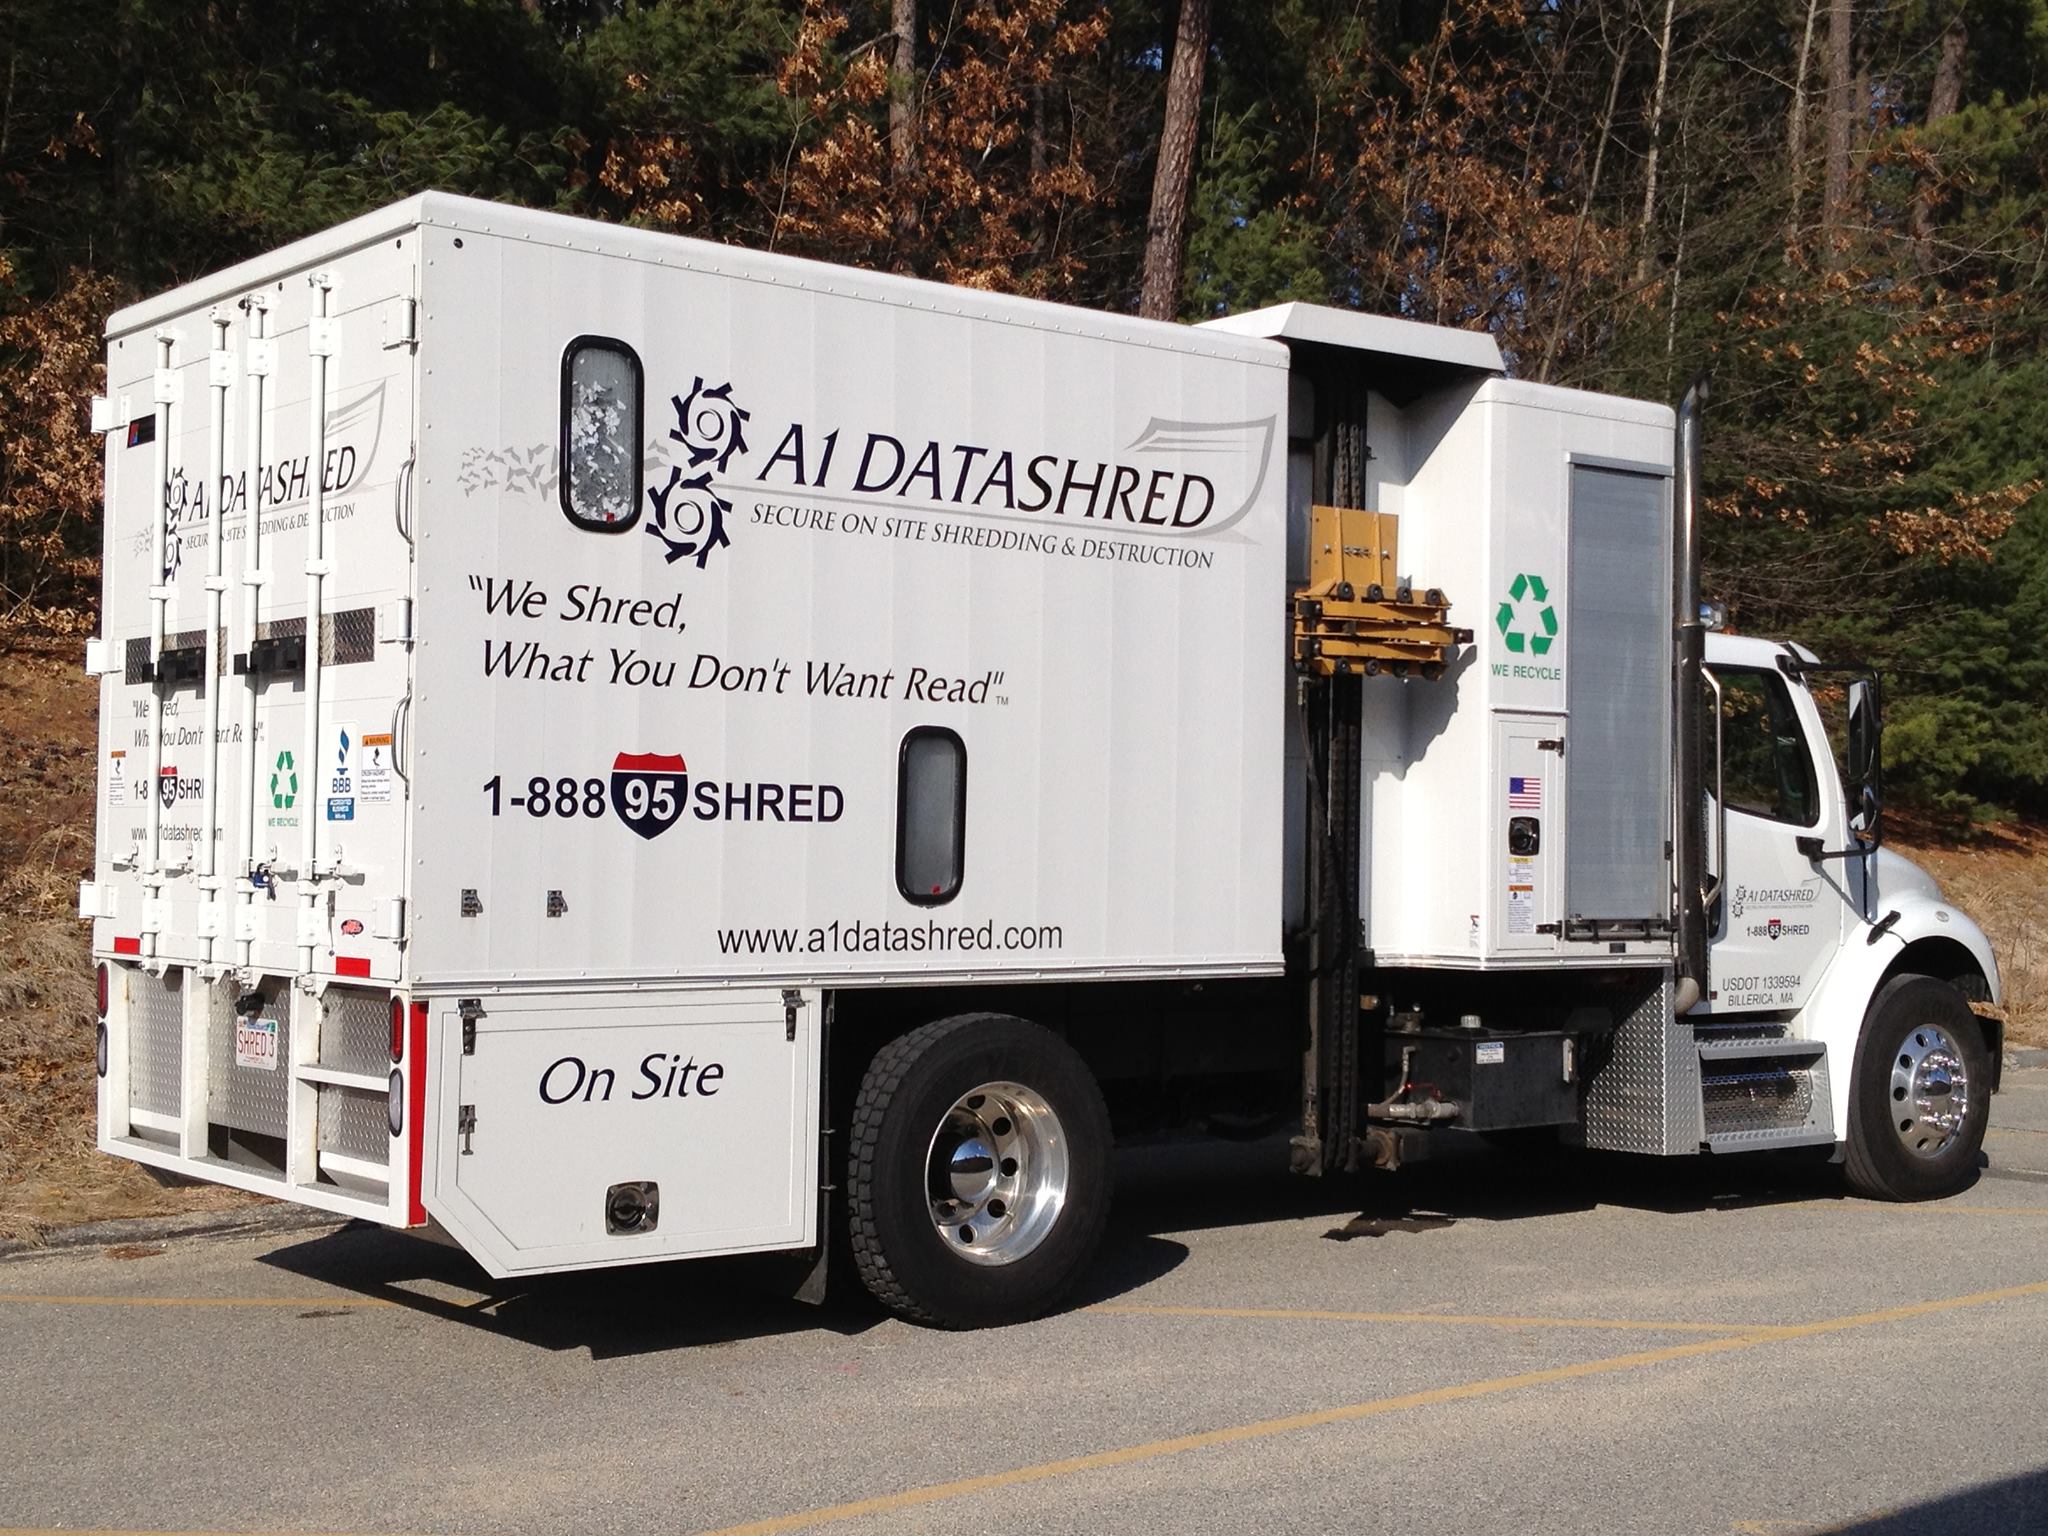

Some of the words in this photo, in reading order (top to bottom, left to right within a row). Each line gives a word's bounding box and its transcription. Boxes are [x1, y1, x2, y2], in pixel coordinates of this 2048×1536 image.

[220, 446, 356, 515] DAASHED
[757, 424, 840, 489] A1
[852, 433, 1215, 528] DATASHRED
[186, 533, 209, 550] SECUR
[297, 503, 356, 528] DEUCTION
[750, 503, 837, 531] SECURE
[841, 513, 878, 535] ON
[882, 517, 927, 540] SITE
[931, 522, 1057, 554] SHREDDING
[1061, 537, 1076, 555] &
[1081, 538, 1214, 569] DESTRUCTION
[468, 575, 547, 618] "We
[560, 585, 687, 634] Shred,
[483, 640, 593, 683] What
[608, 649, 674, 688] You
[688, 654, 791, 695] Don't
[805, 661, 894, 700] Want
[903, 667, 1005, 705] Read"
[1491, 664, 1509, 677] WE
[1513, 666, 1561, 681] RECYCLE
[133, 780, 149, 800] 1-8
[162, 780, 176, 800] 95
[179, 779, 205, 800] SHR
[332, 777, 351, 793] BBB
[483, 776, 606, 818] 1-888
[624, 779, 677, 821] 95
[693, 781, 845, 822] SHRED
[1760, 889, 1814, 902] DATASHRED
[717, 920, 1064, 954] www.a1datashred.com
[1746, 926, 1768, 937] 1-888
[1771, 925, 1780, 937] 95
[1782, 925, 1810, 936] SHRED
[1722, 977, 1760, 992] USDOT
[1763, 975, 1801, 990] 1339594
[1780, 992, 1794, 1004] MA
[238, 1030, 267, 1056] SHRED
[269, 1033, 275, 1057] 3
[538, 1056, 616, 1106] On
[631, 1053, 725, 1100] Site
